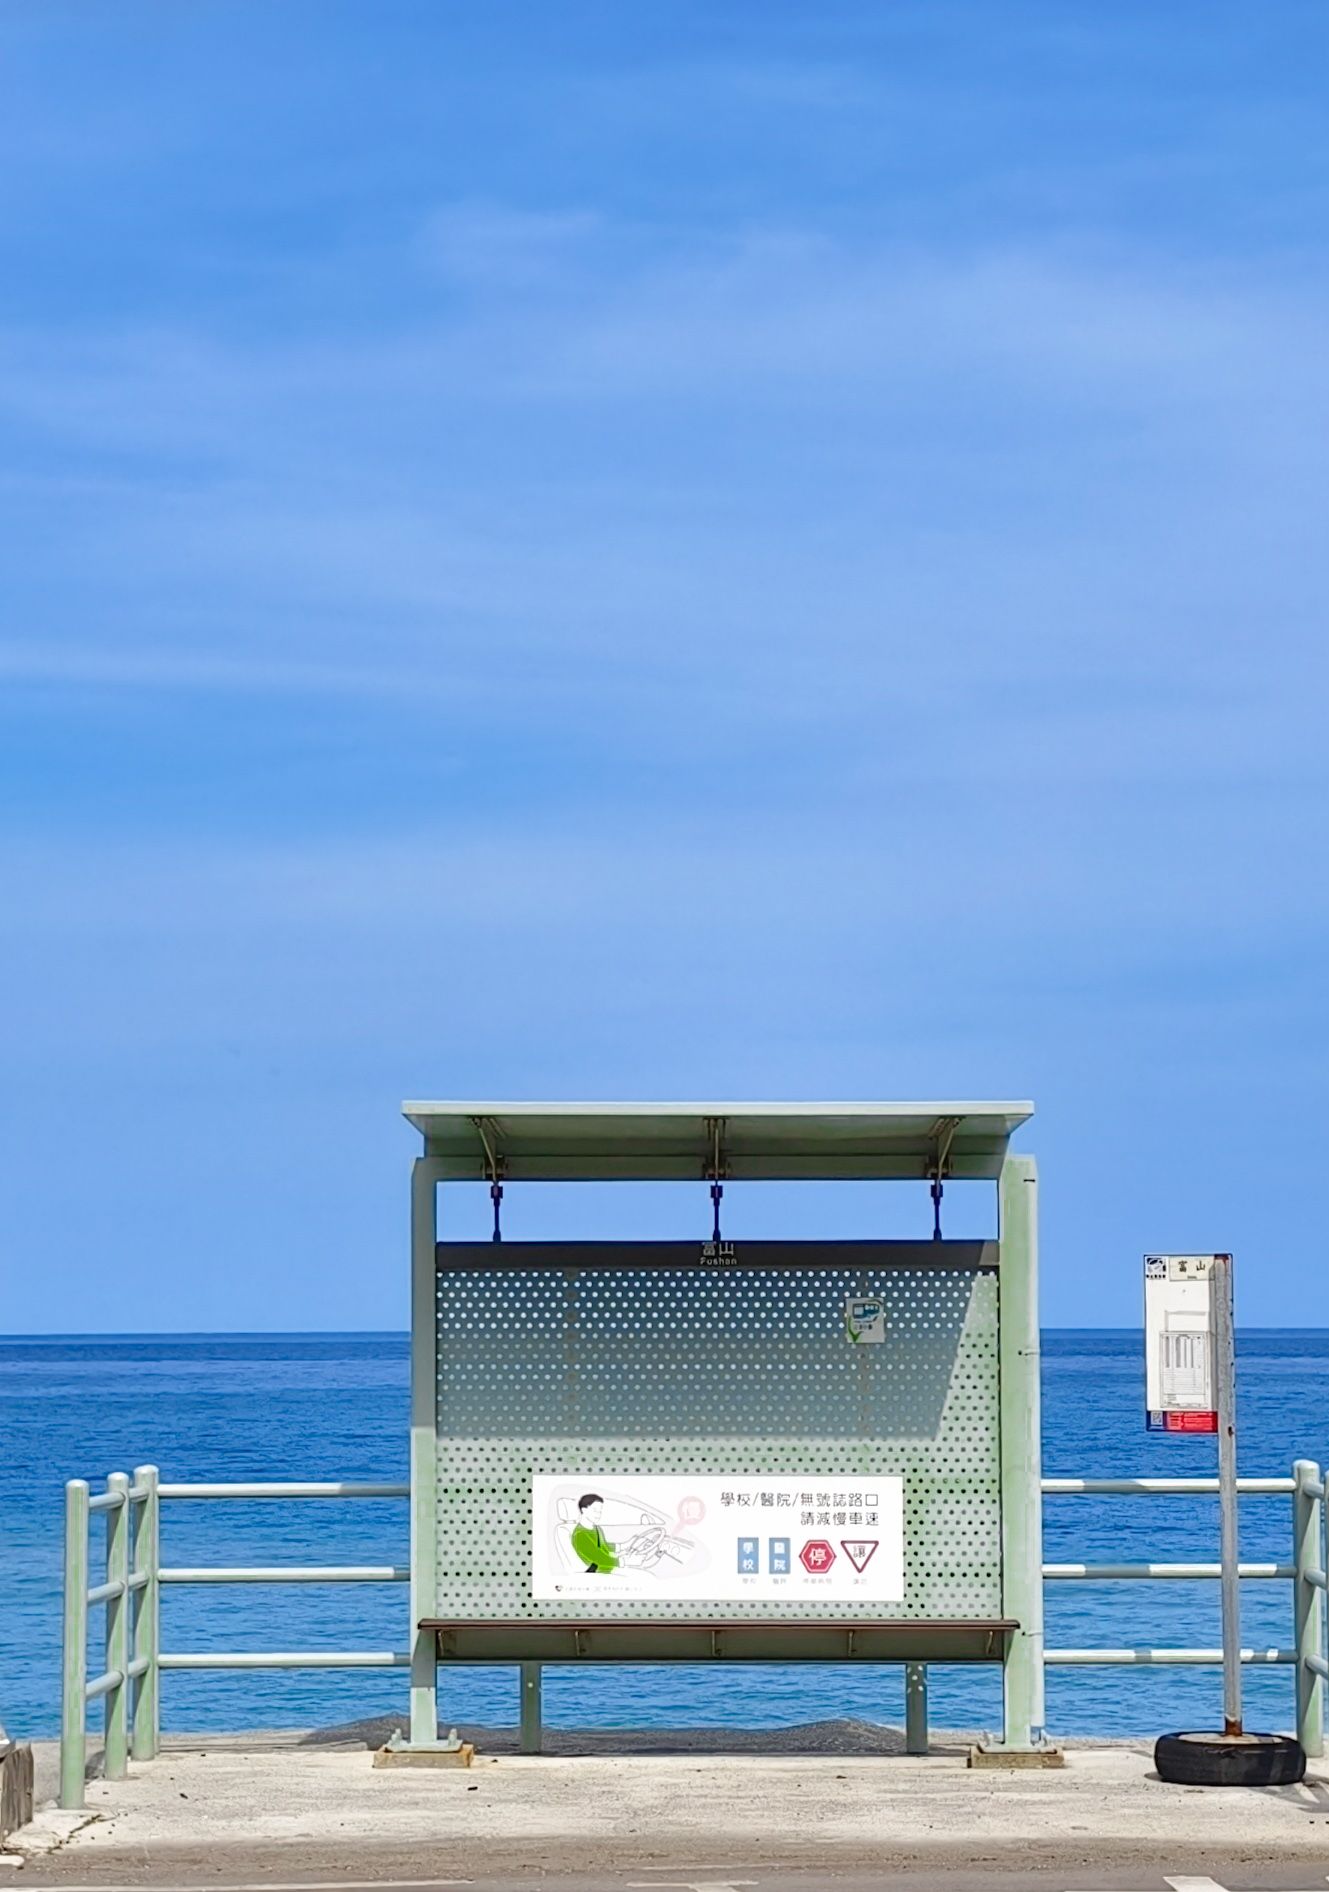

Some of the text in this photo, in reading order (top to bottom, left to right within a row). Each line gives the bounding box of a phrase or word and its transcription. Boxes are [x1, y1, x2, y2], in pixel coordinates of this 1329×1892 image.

[800, 1512, 879, 1526] 請減慢車速
[809, 1548, 827, 1566] 停
